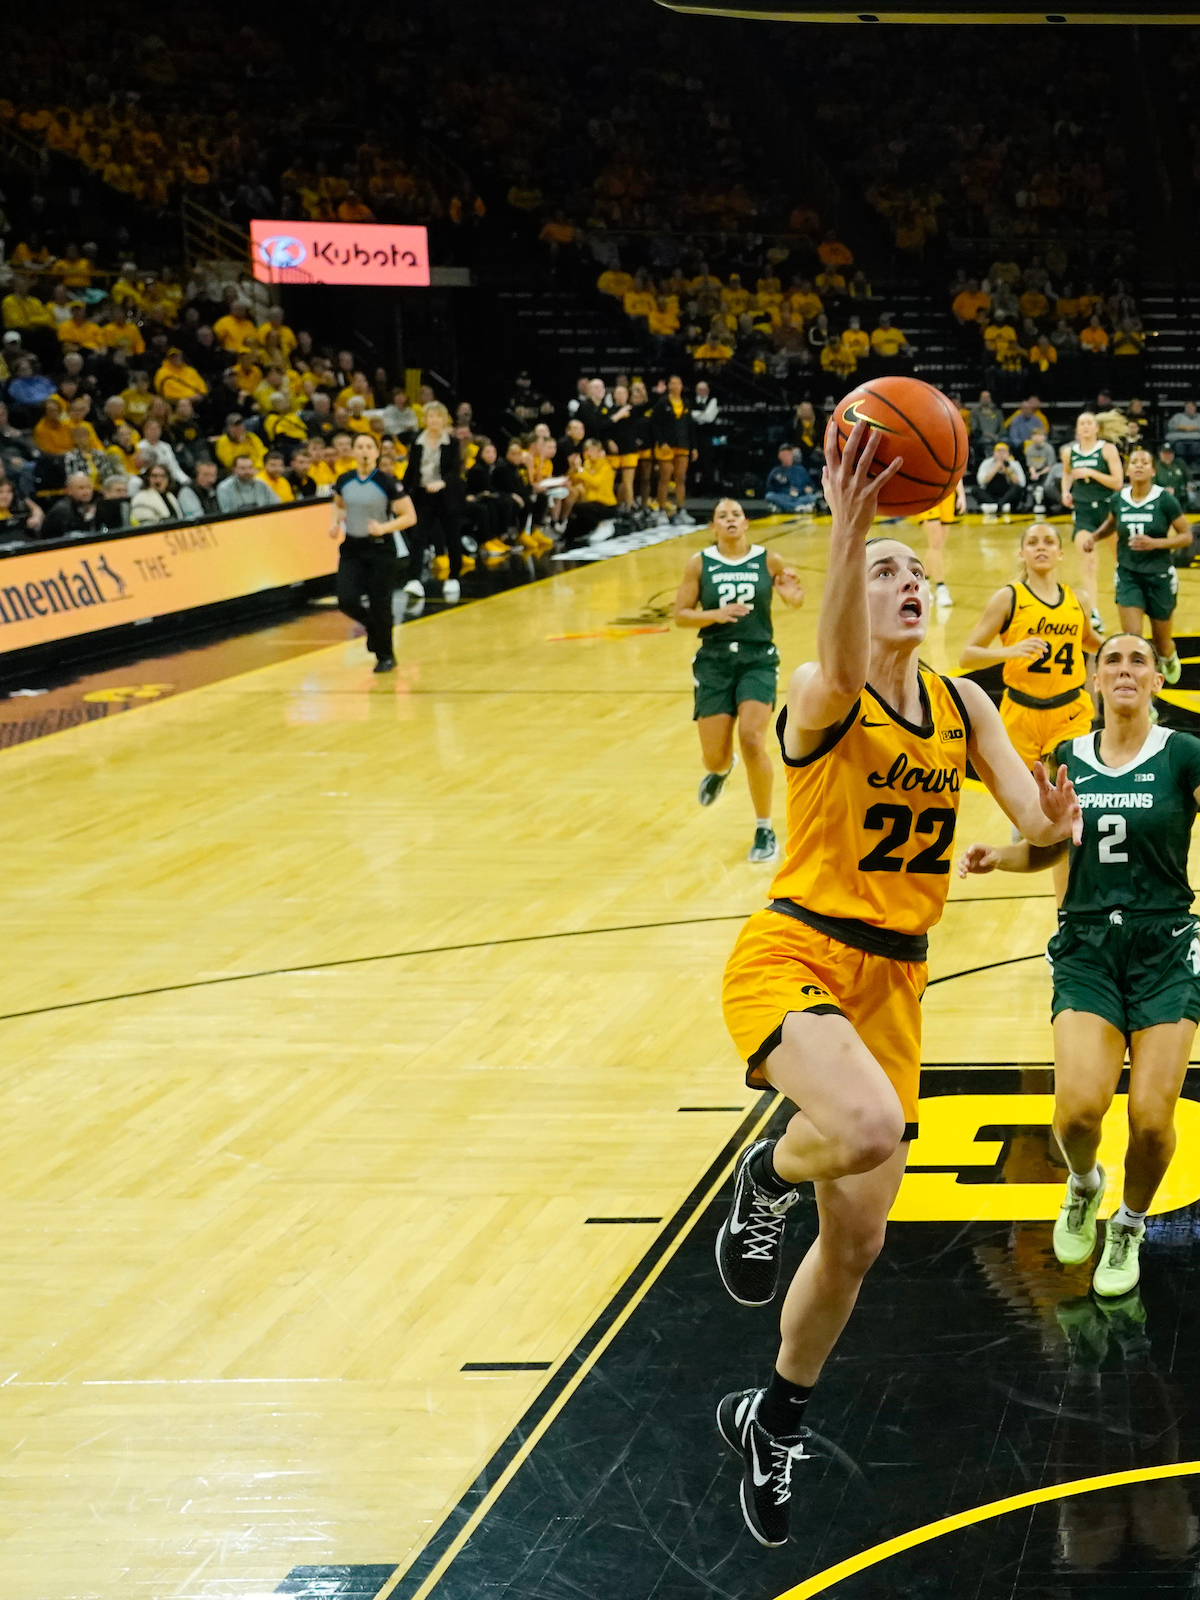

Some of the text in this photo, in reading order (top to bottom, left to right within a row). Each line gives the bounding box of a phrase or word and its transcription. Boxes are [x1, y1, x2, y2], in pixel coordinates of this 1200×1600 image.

[313, 241, 417, 267] Kubota
[134, 554, 173, 582] THE
[717, 583, 755, 611] 22
[1027, 616, 1079, 636] Iowa
[1027, 641, 1074, 675] 24
[867, 752, 960, 793] Iowa
[1078, 793, 1154, 809] SPARTANS
[858, 803, 957, 874] 22
[1097, 814, 1129, 864] 2
